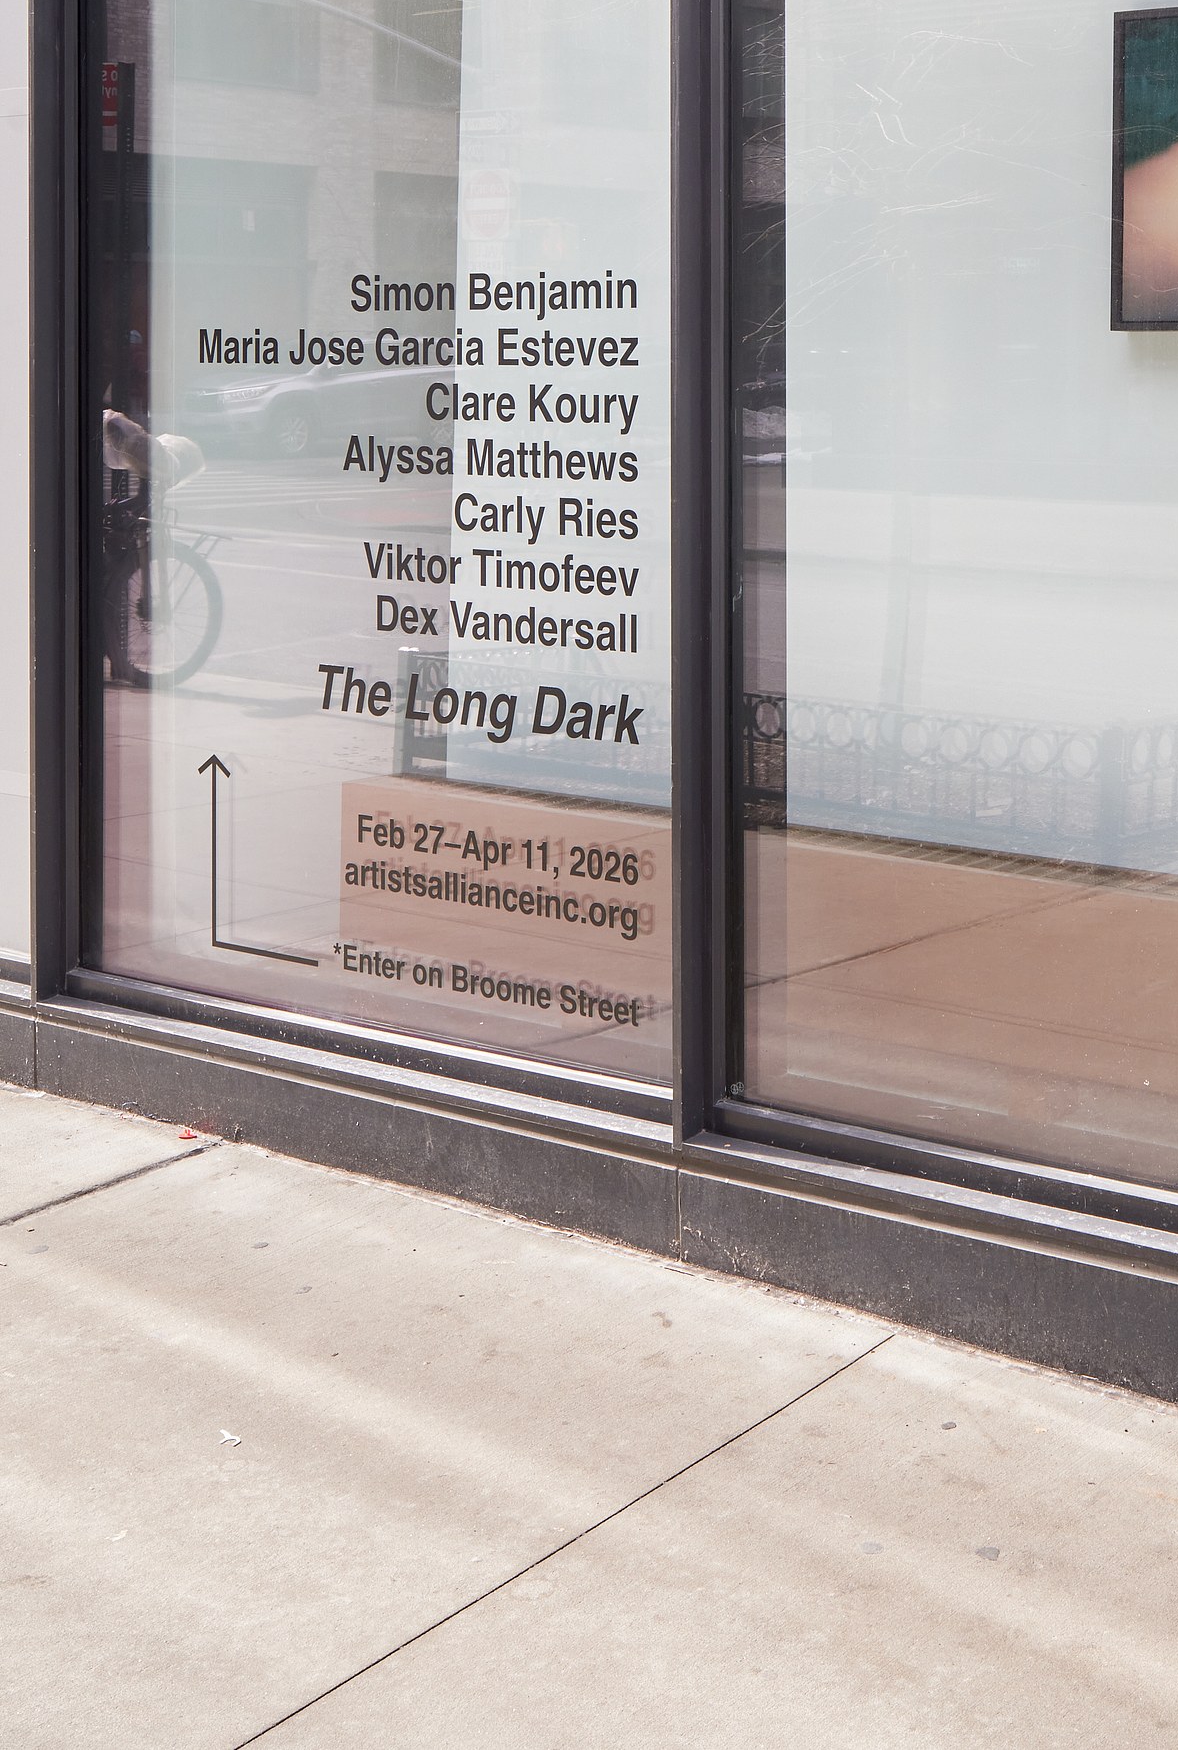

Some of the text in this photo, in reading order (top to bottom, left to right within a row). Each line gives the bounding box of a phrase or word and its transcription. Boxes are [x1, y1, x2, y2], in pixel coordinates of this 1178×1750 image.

[350, 270, 637, 321] Simon Benjamin
[199, 327, 639, 367] Maria Jose Garcia Estevez
[426, 382, 639, 435] Clare Koury
[343, 435, 639, 483] Alyssa Matthews
[454, 492, 639, 545] Carly Ries
[363, 541, 640, 597] Viktor Timofeev
[377, 594, 637, 654] Dex Vandersall
[318, 664, 645, 745] The Long Dark
[358, 814, 405, 850] Feb
[521, 839, 559, 880] 11,
[569, 846, 639, 886] 2026
[345, 859, 639, 941] artistsallianceinc.org
[412, 964, 443, 989] on
[451, 964, 551, 1010] Broome
[559, 984, 639, 1027] Street
